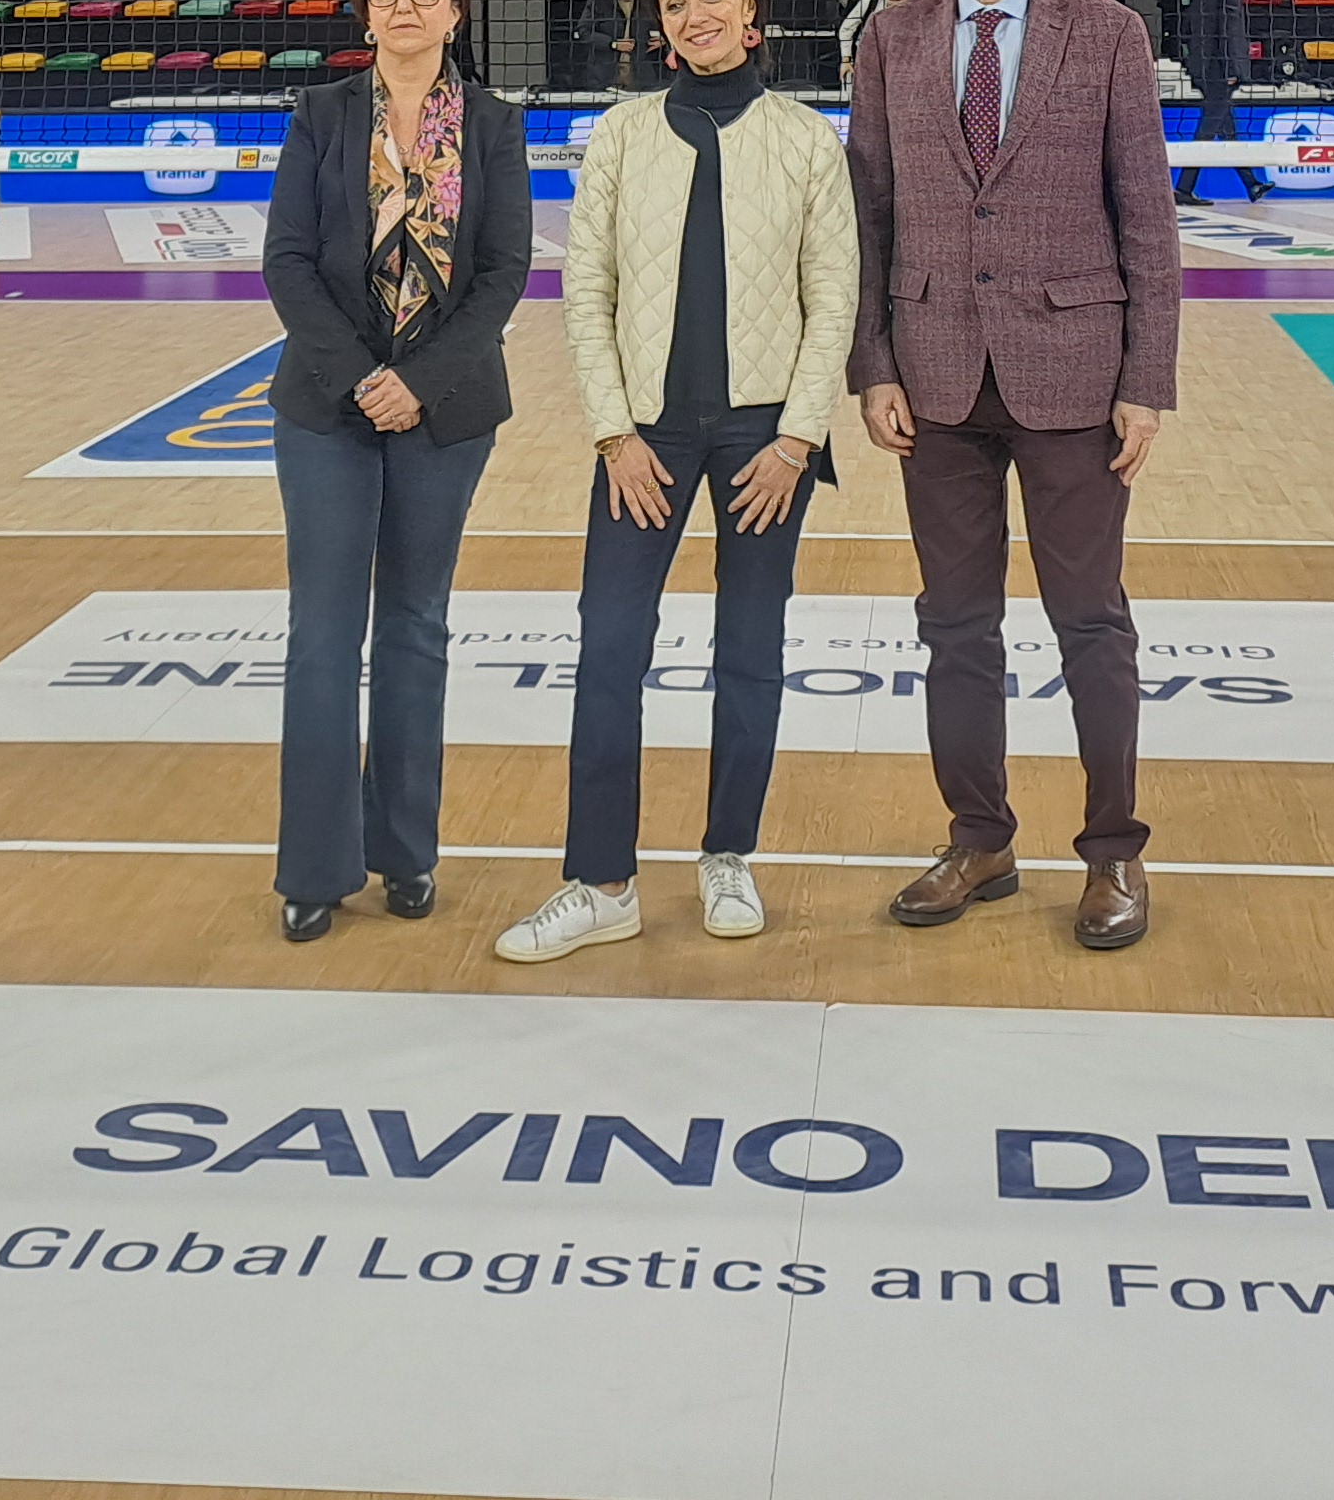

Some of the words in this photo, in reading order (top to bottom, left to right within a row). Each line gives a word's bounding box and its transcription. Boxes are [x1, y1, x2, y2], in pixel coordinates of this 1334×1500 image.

[531, 150, 584, 162] unobra
[1149, 642, 1277, 662] Glob
[71, 1101, 904, 1195] SAVINO
[358, 1235, 829, 1296] Logistics
[870, 1261, 1061, 1306] and
